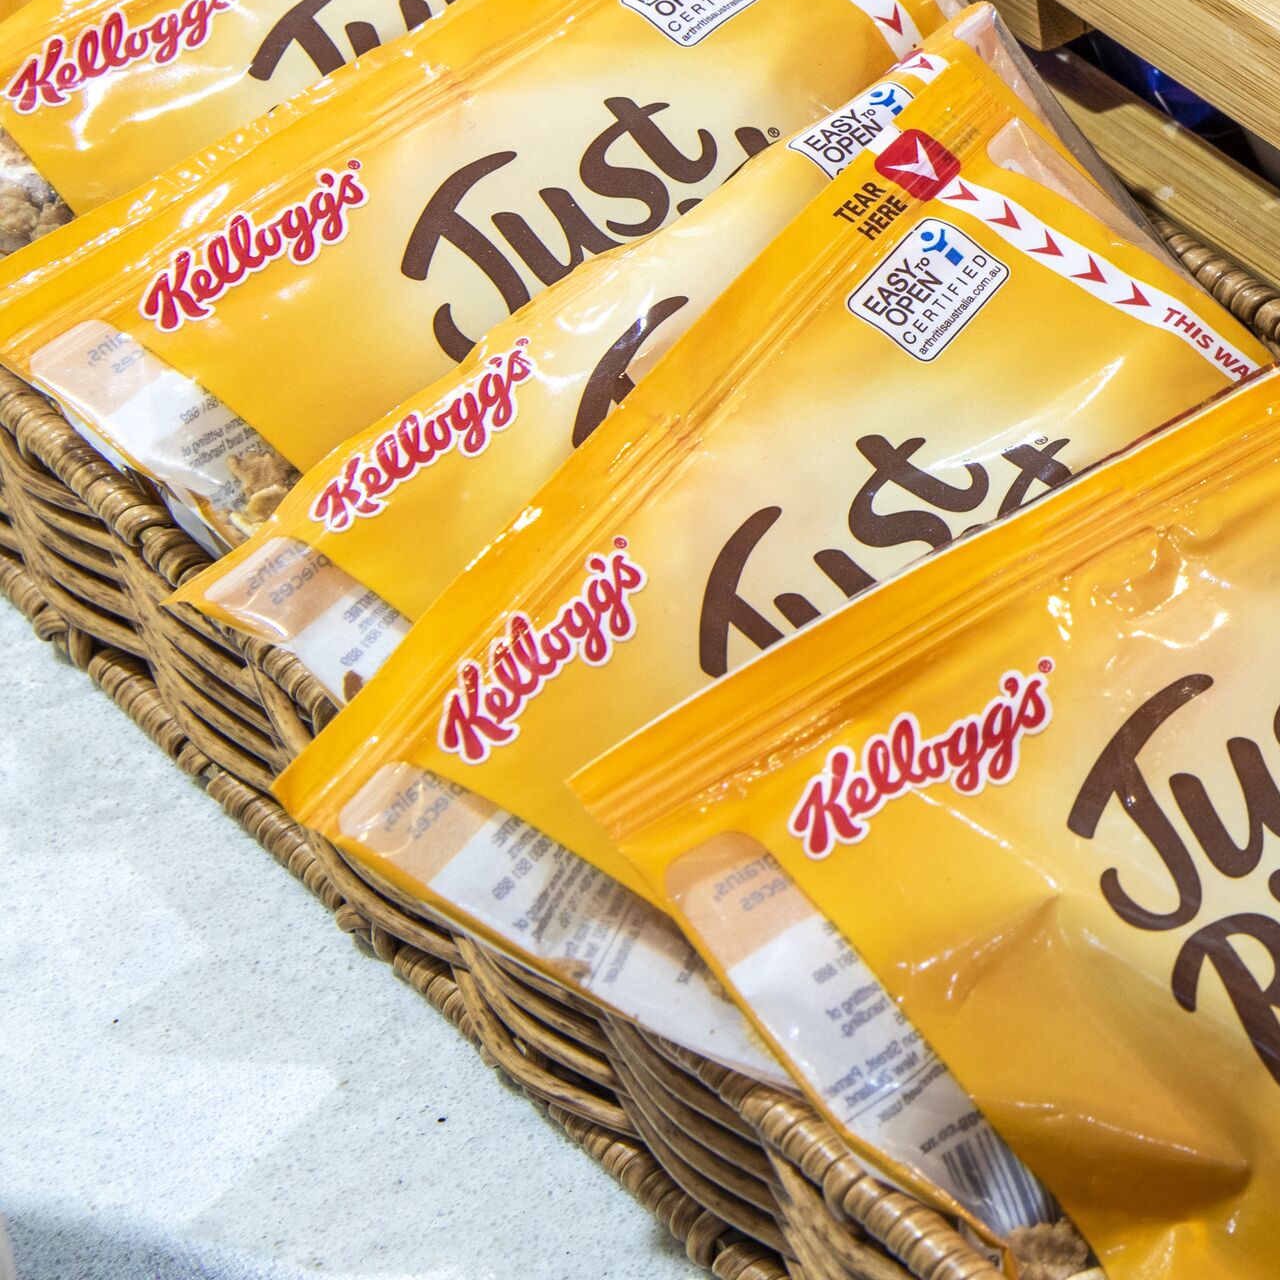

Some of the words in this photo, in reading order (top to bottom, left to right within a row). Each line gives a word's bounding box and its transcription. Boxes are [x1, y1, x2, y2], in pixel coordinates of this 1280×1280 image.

[803, 108, 862, 152] EASY
[861, 108, 876, 119] TO
[823, 118, 883, 163] OPEN
[400, 96, 718, 363] Just
[833, 182, 886, 223] TEAR
[857, 194, 908, 241] HERE
[144, 172, 365, 331] Kellogg's
[862, 258, 918, 316] EASY
[914, 257, 930, 272] TO
[885, 270, 943, 326] OPEN
[903, 254, 987, 345] CERTIFIED
[919, 265, 1002, 355] arthritisaustralia.com.au
[1163, 307, 1214, 350] THIS
[1214, 346, 1252, 380] WA
[316, 351, 531, 528] Kellogg's
[443, 554, 641, 760] Kellogg's
[793, 677, 1046, 855] Kellogg's
